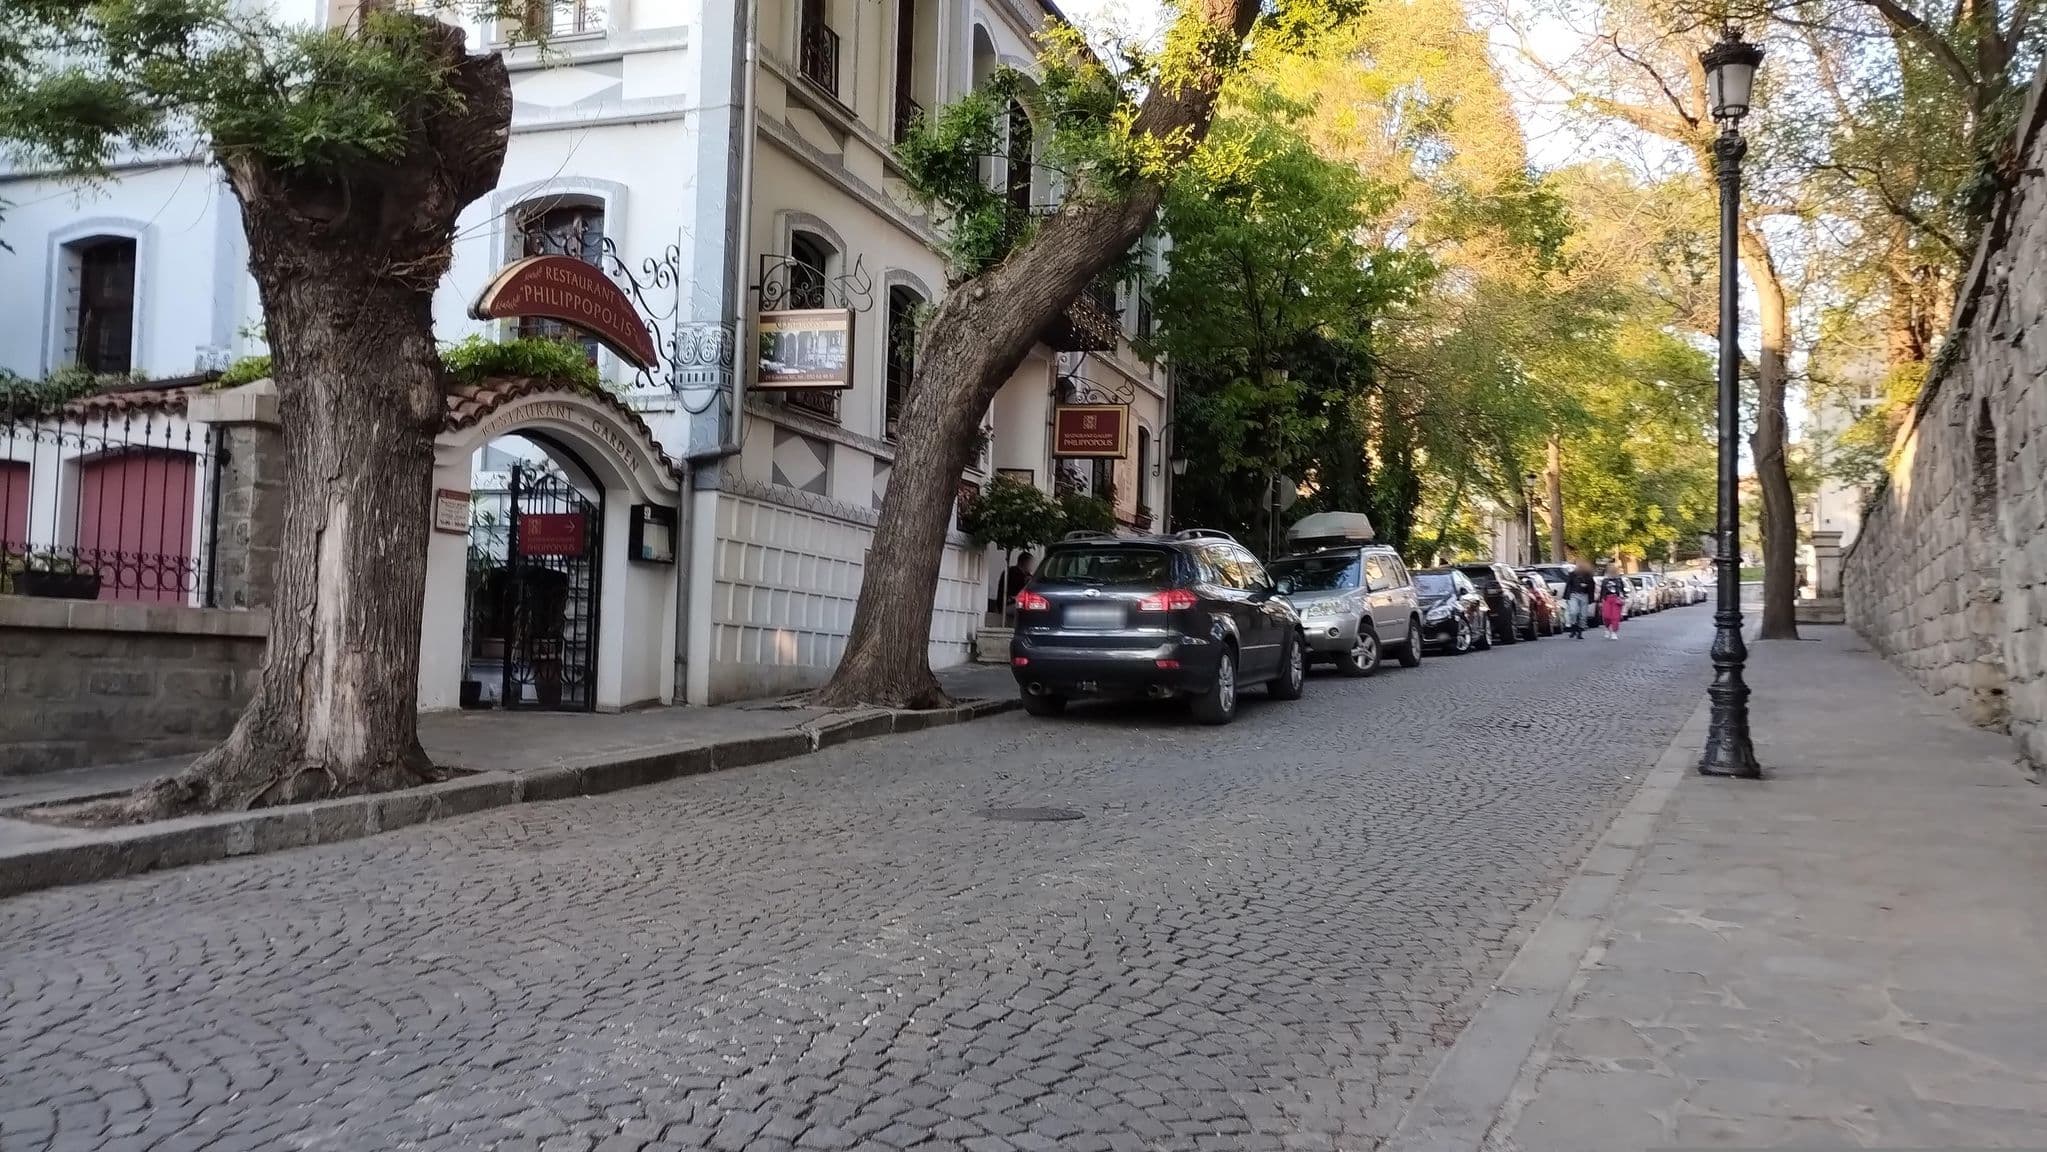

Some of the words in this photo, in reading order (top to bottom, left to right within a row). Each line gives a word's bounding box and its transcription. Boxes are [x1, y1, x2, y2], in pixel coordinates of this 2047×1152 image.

[545, 266, 616, 304] RESTAURANT
[481, 403, 574, 436] RESTAURANT
[592, 420, 640, 473] GARDEN
